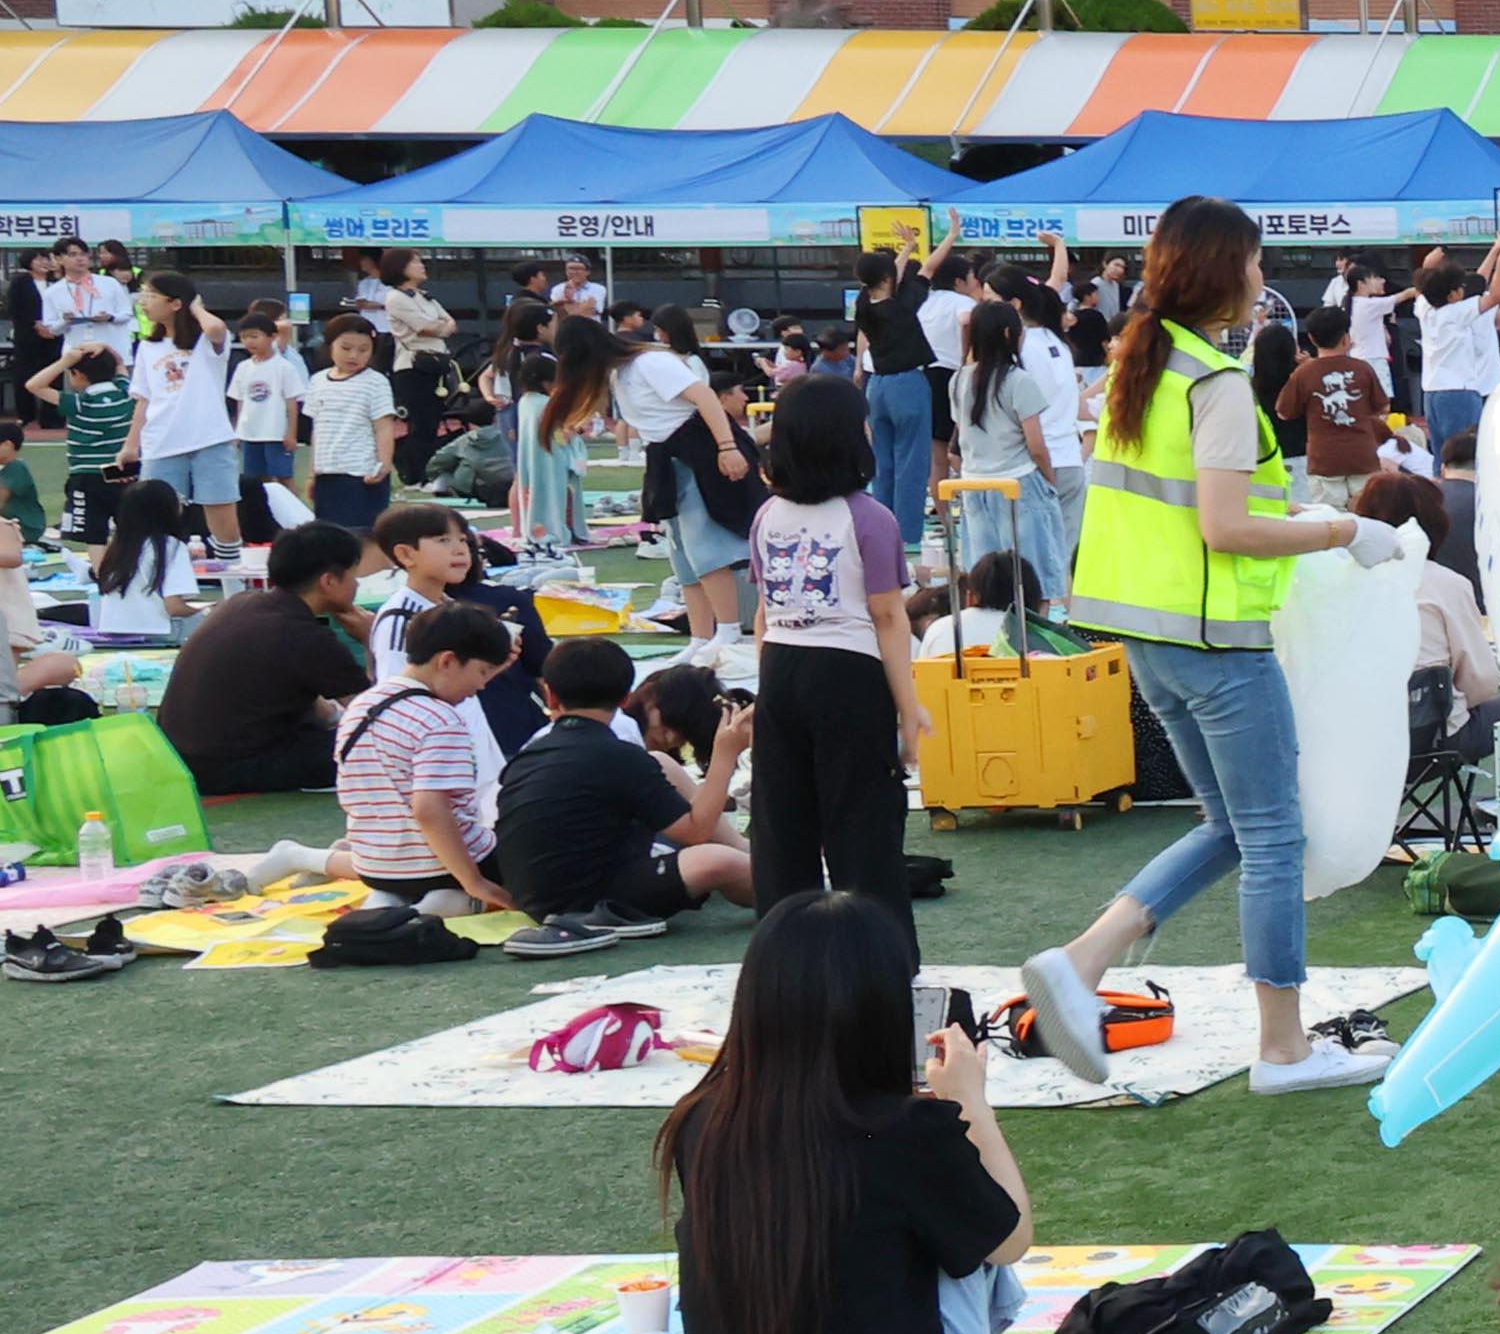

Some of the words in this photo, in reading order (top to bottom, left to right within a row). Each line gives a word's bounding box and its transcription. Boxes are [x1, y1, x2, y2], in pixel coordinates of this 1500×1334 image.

[370, 218, 430, 239] 브리즈
[557, 215, 654, 238] 운영/안내
[72, 490, 86, 533] THREE
